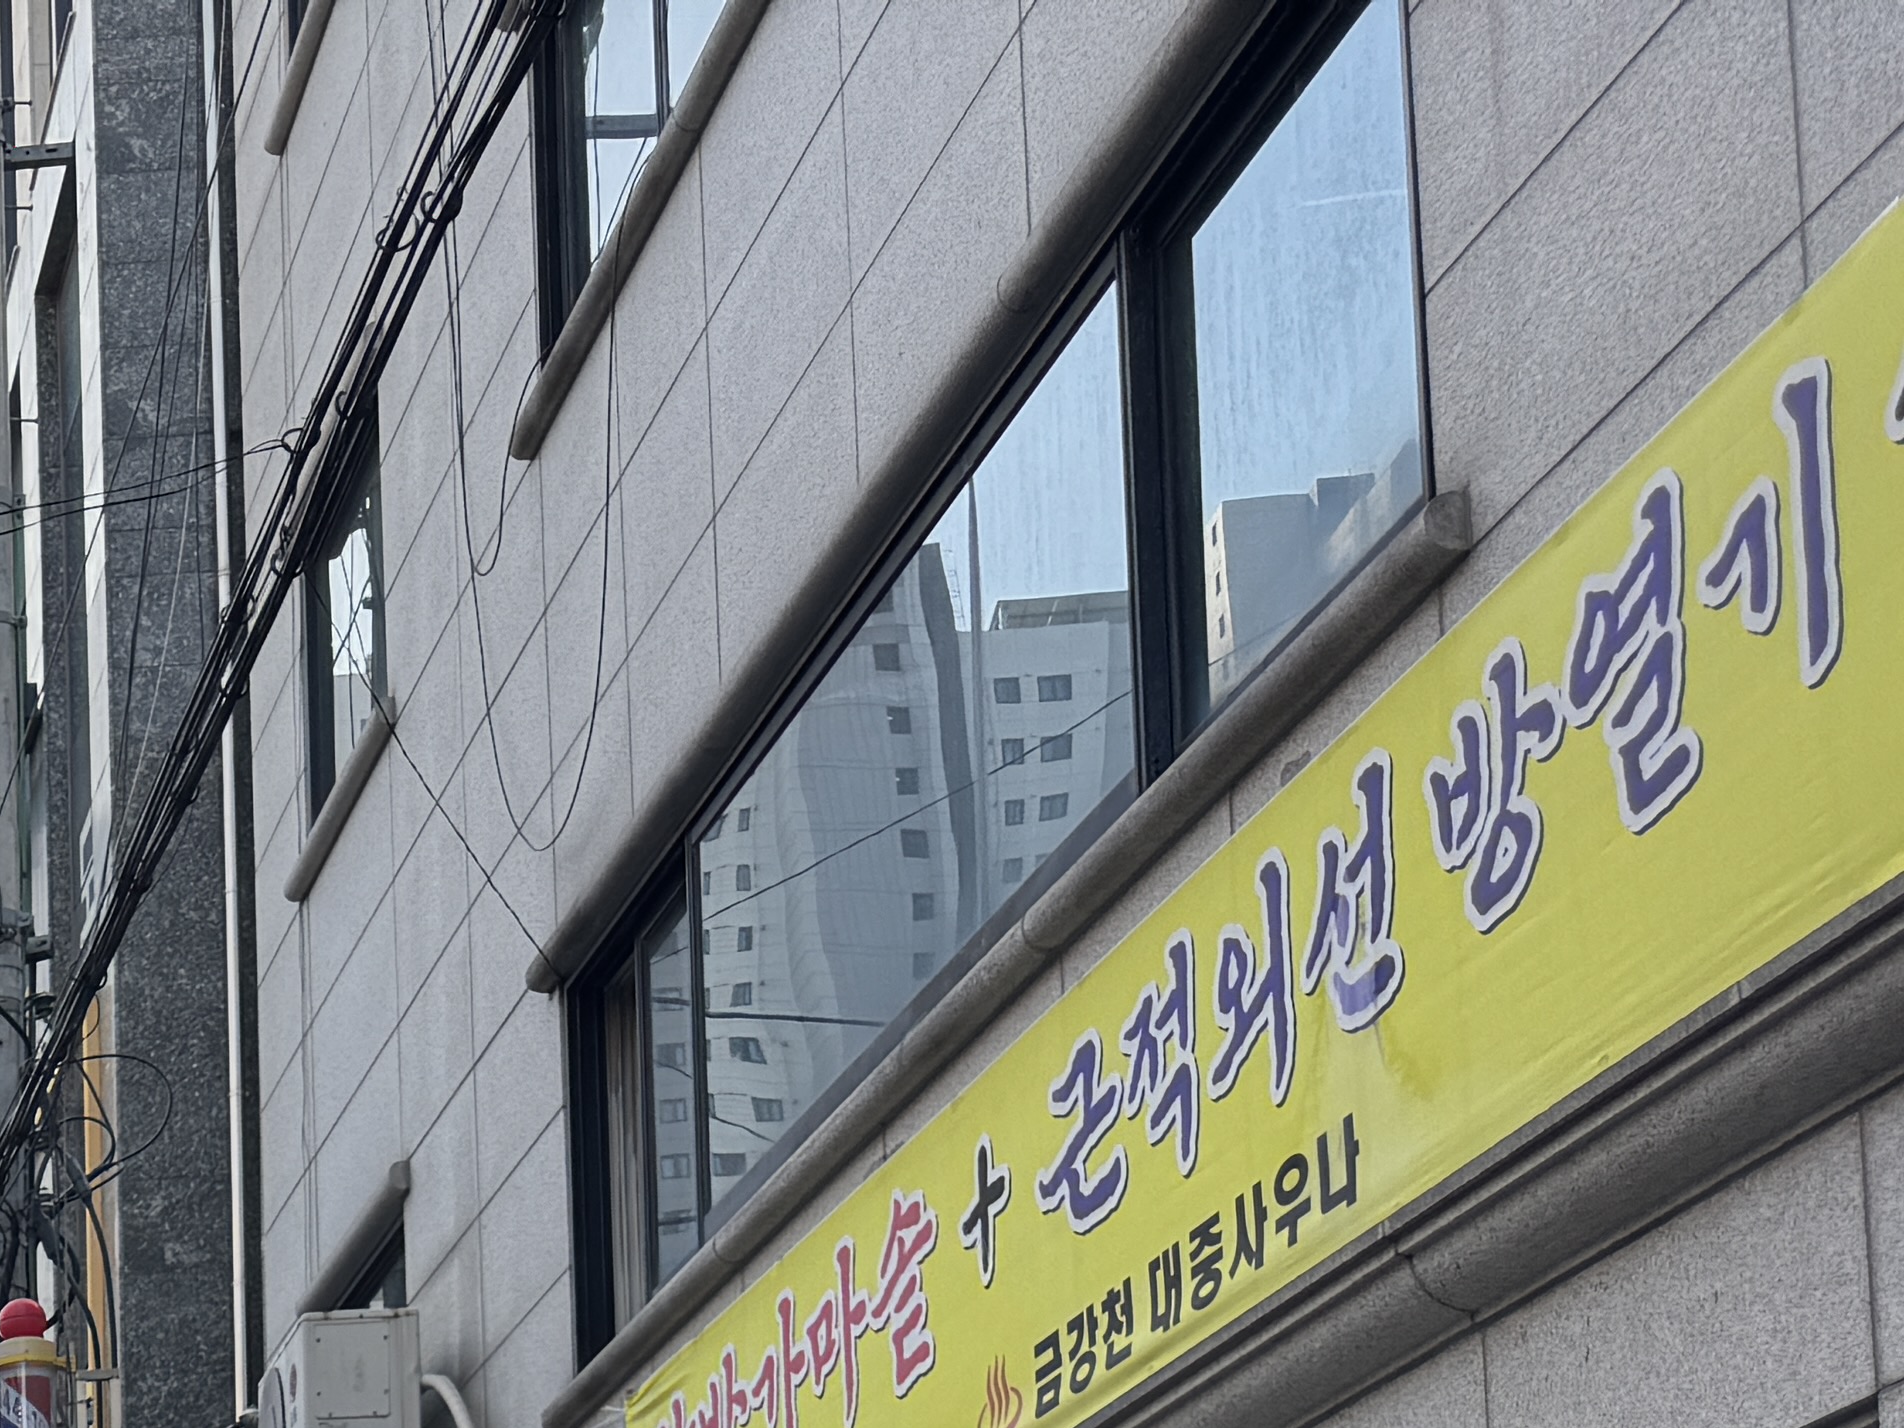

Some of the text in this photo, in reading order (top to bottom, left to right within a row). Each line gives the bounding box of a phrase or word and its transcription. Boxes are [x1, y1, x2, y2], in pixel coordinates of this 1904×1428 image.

[1034, 746, 1406, 1232] 근적외선
[1427, 355, 1845, 933] 방열기
[1032, 1115, 1362, 1422] 금강천 대중사우나
